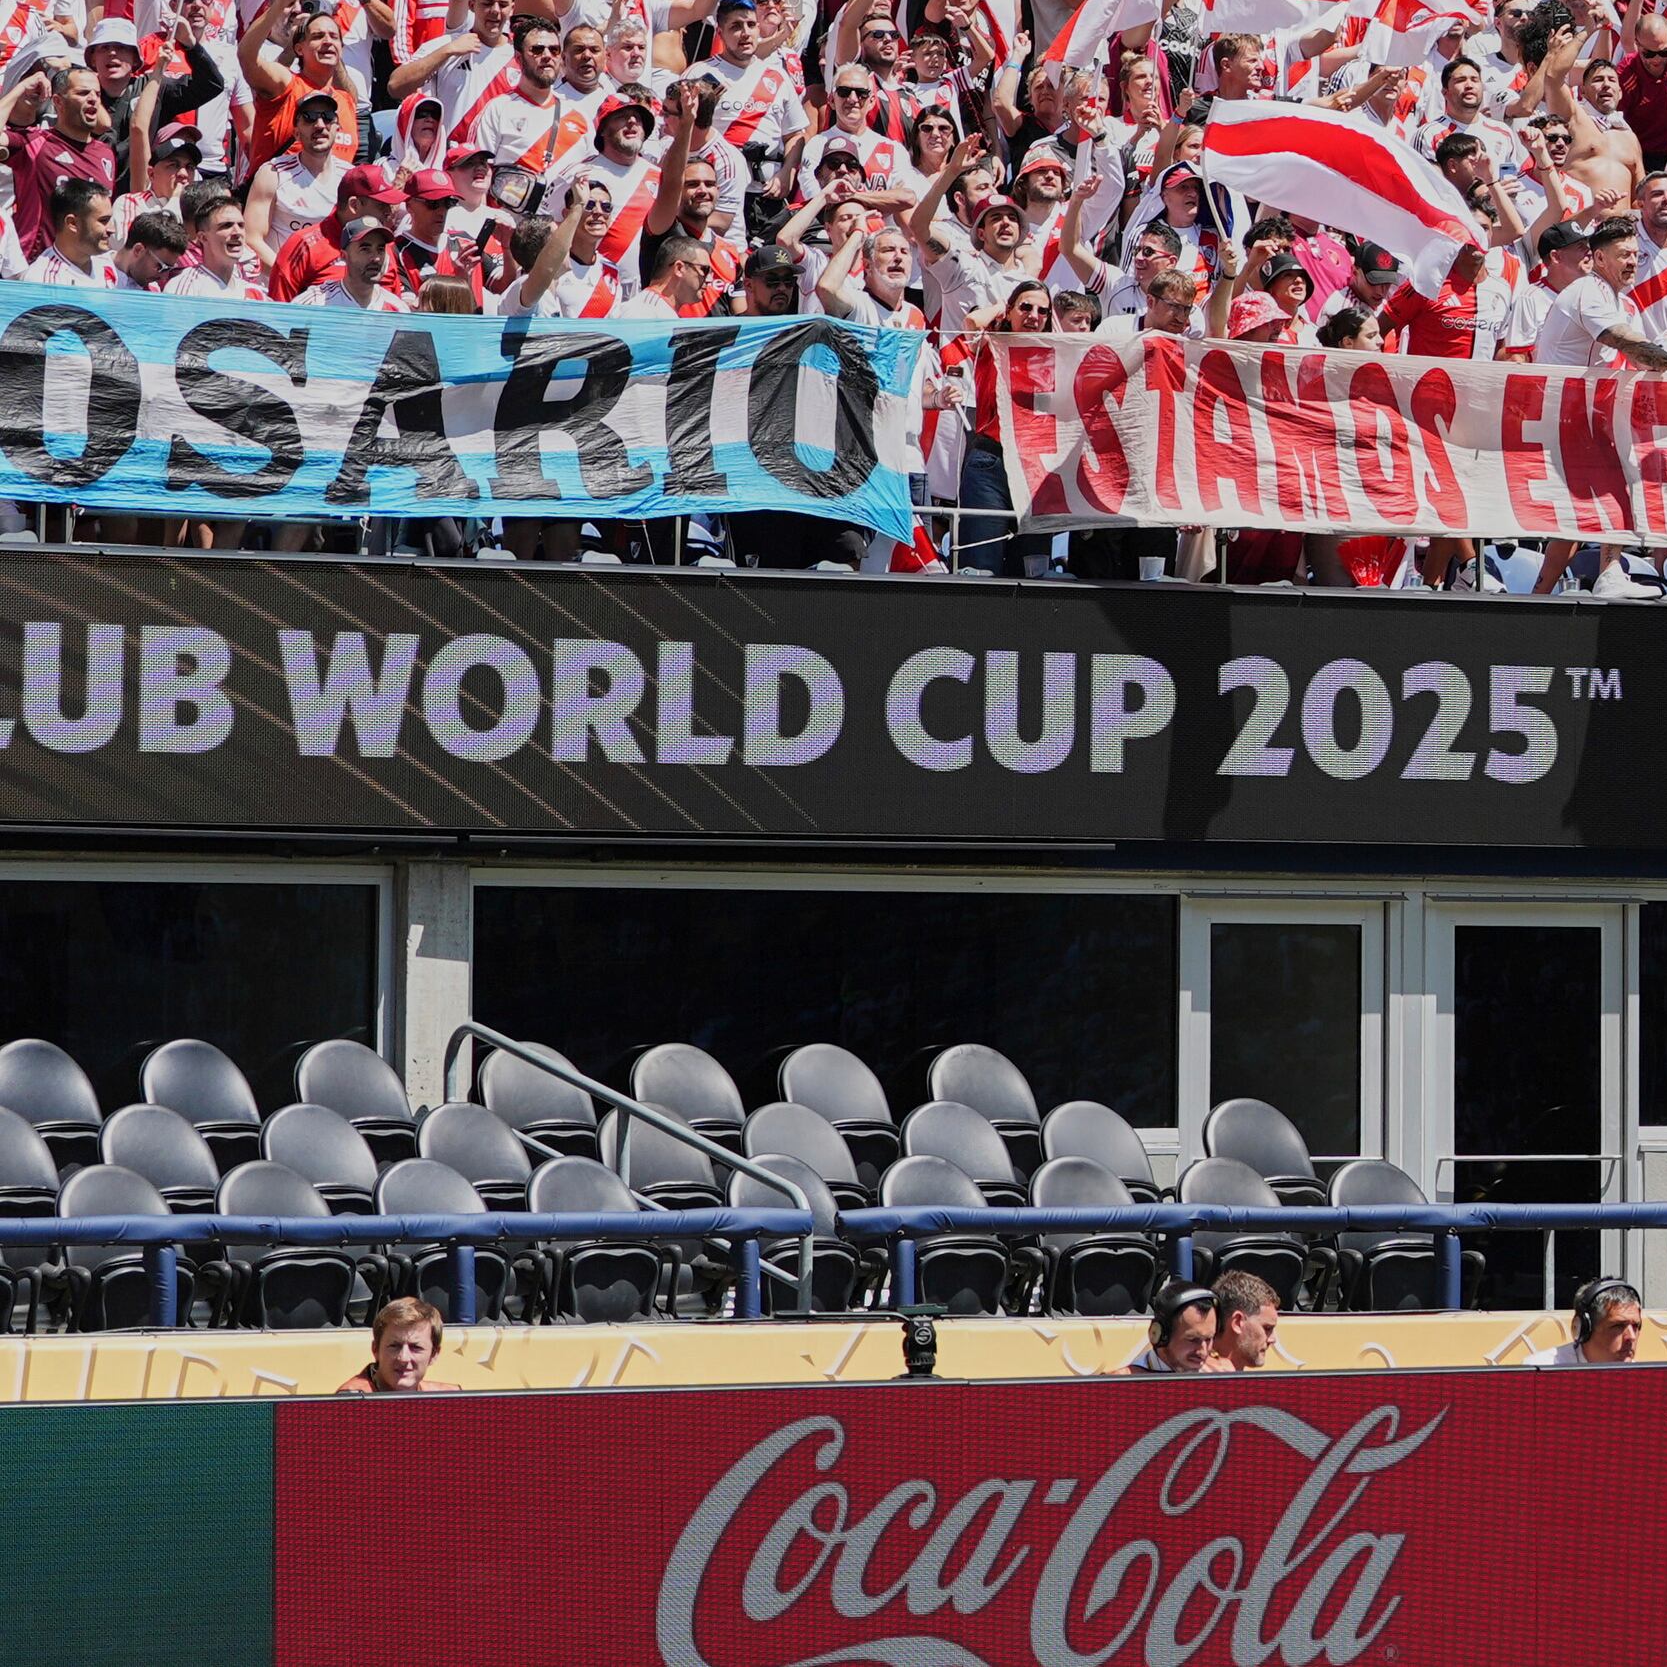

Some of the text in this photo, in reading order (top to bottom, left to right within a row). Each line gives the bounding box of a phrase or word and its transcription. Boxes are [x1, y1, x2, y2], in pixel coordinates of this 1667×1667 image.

[720, 99, 782, 117] codere
[0, 304, 881, 507] OSARIO
[1442, 316, 1507, 334] codere
[1008, 335, 1468, 529] ESTAMOS
[0, 621, 237, 755] UB
[277, 628, 847, 769] WORLD
[884, 644, 1177, 777] CUP
[655, 1402, 1453, 1667] Coca-Cola
